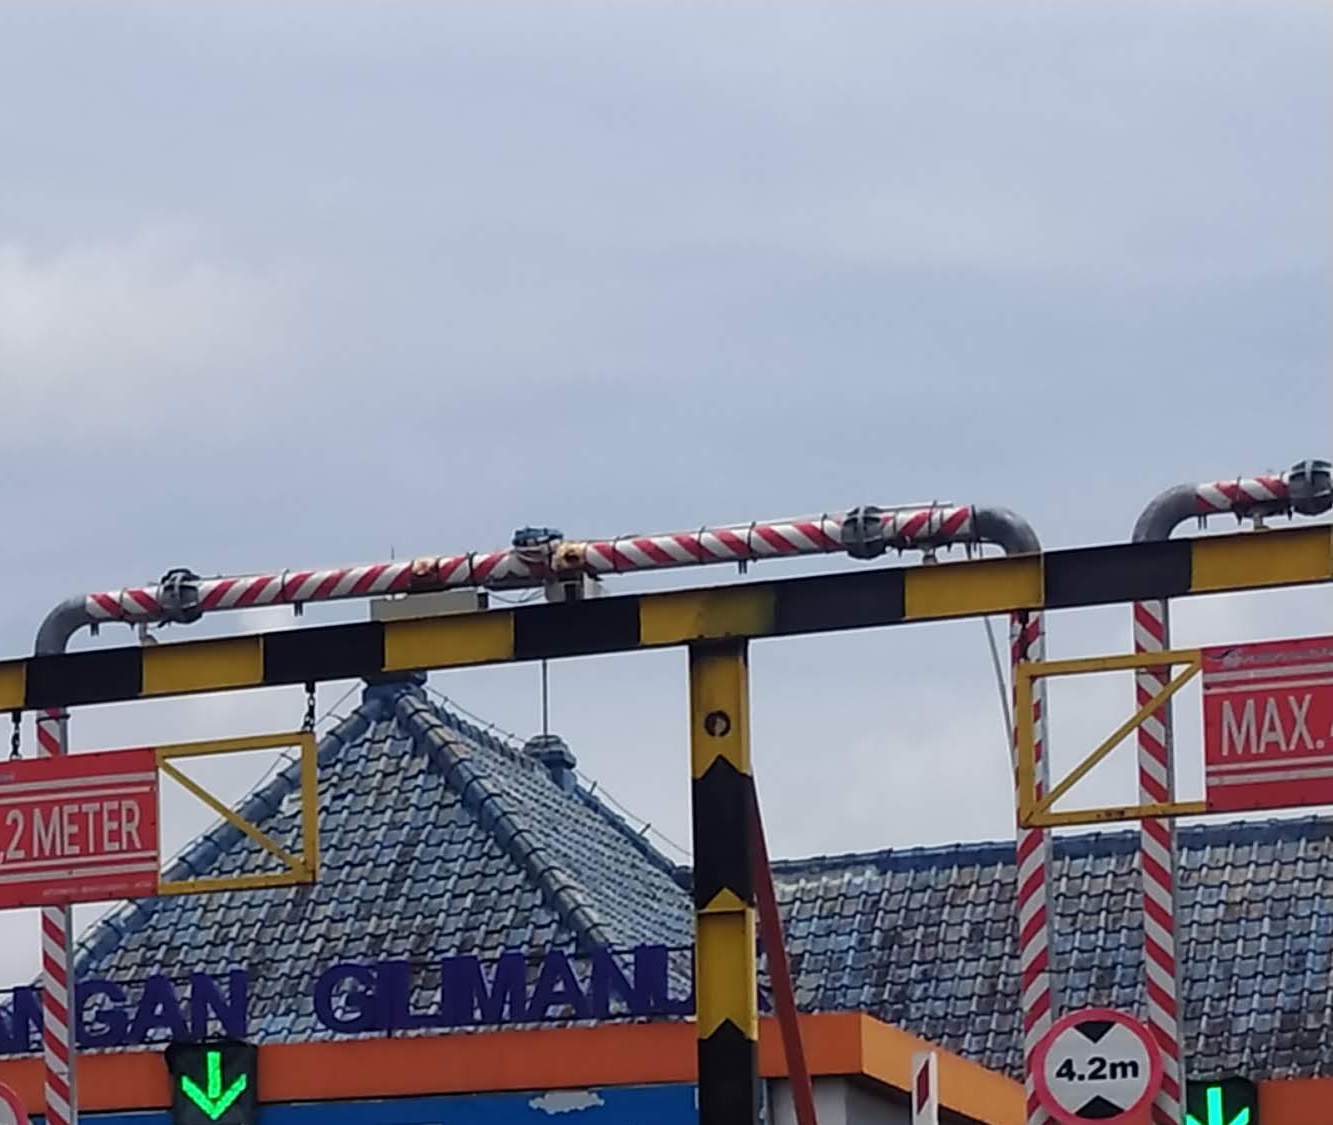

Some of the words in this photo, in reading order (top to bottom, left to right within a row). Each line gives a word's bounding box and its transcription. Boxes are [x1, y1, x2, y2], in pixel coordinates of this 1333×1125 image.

[1221, 693, 1326, 757] MAX.
[32, 799, 142, 859] METER
[1055, 1056, 1140, 1083] 4.2m
